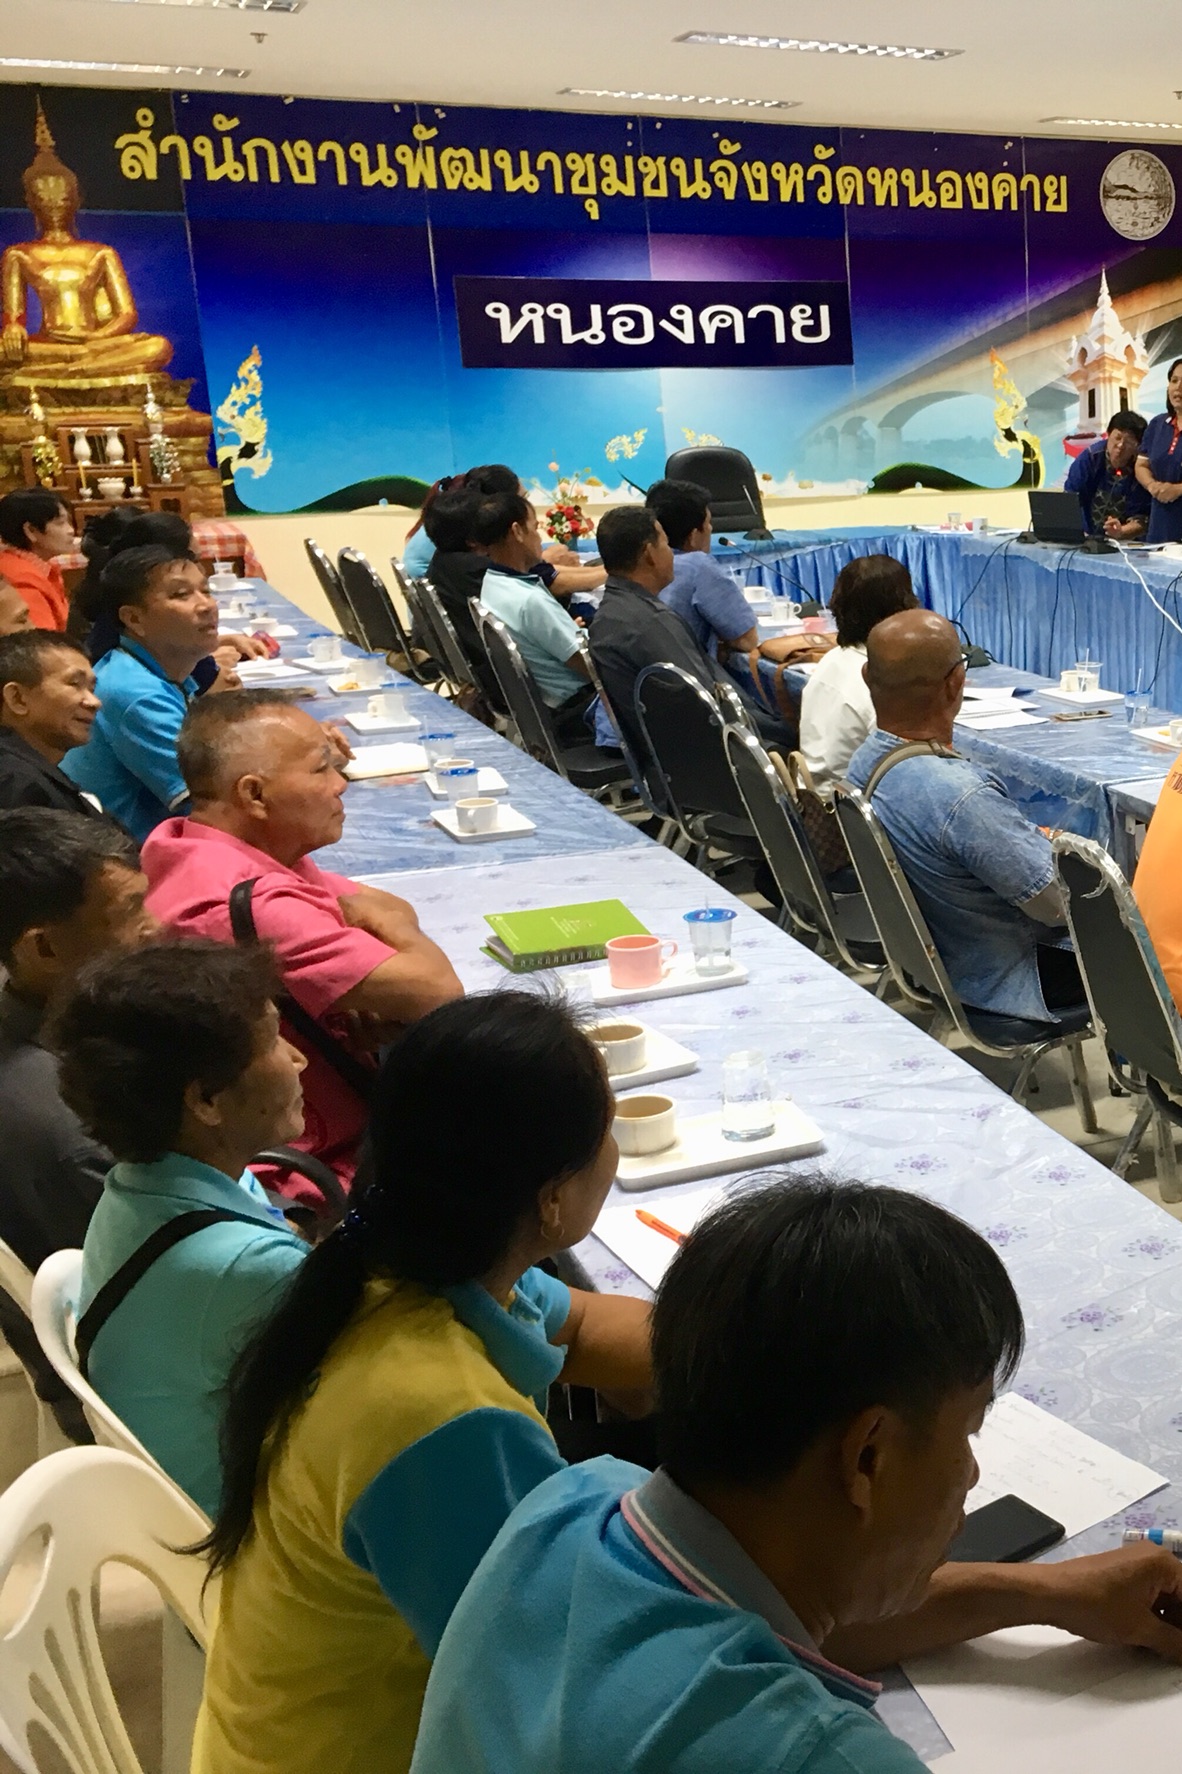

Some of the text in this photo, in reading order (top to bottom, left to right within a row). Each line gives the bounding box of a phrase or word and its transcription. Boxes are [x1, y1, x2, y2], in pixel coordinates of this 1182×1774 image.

[115, 106, 1067, 220] สำนักงานพัฒนาชุมชนจังหวัดหนองคาย
[484, 301, 831, 345] หนองคาย
